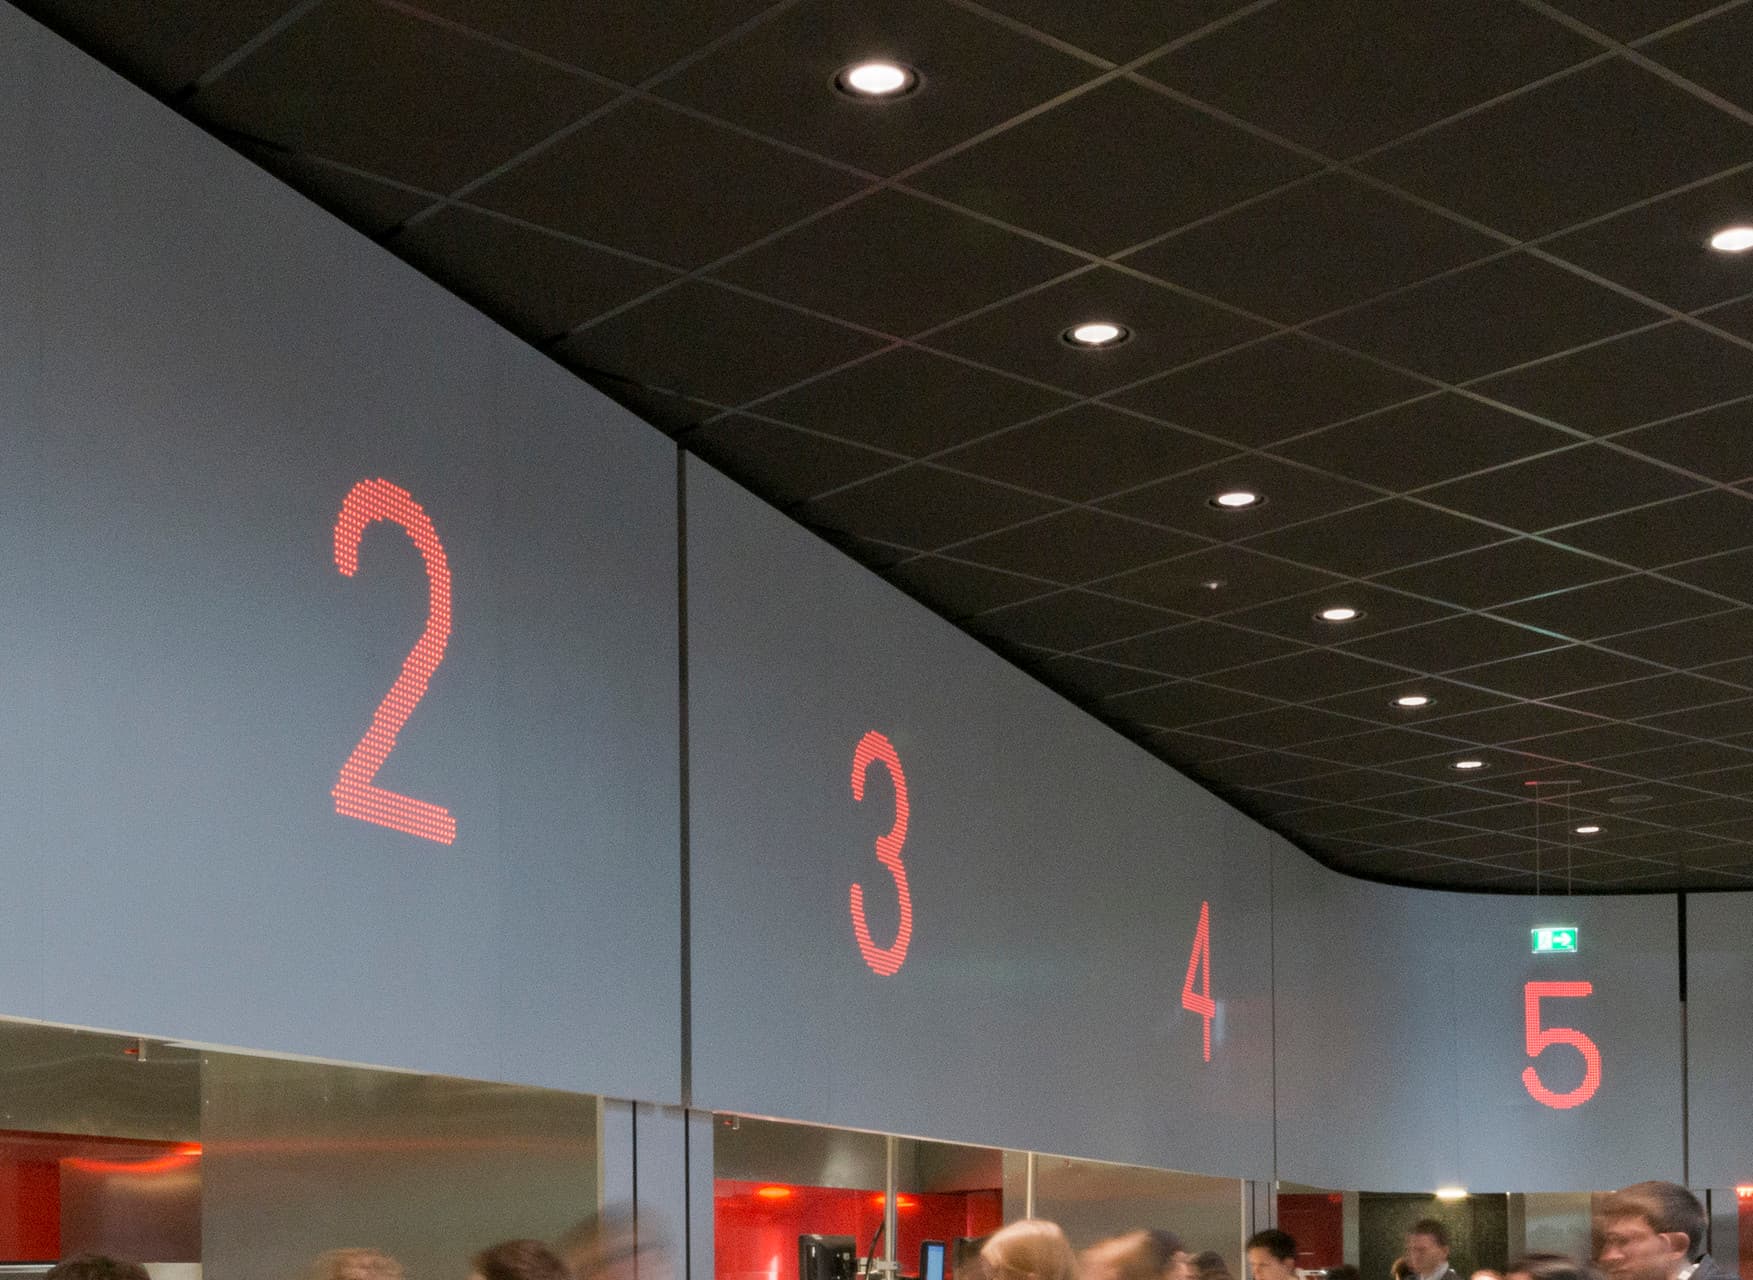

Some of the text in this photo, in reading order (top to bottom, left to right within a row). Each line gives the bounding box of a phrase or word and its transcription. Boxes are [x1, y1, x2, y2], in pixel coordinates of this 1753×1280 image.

[331, 478, 456, 845] 2
[849, 730, 912, 976] 3
[1181, 900, 1216, 1062] 4
[1522, 981, 1602, 1109] 5
